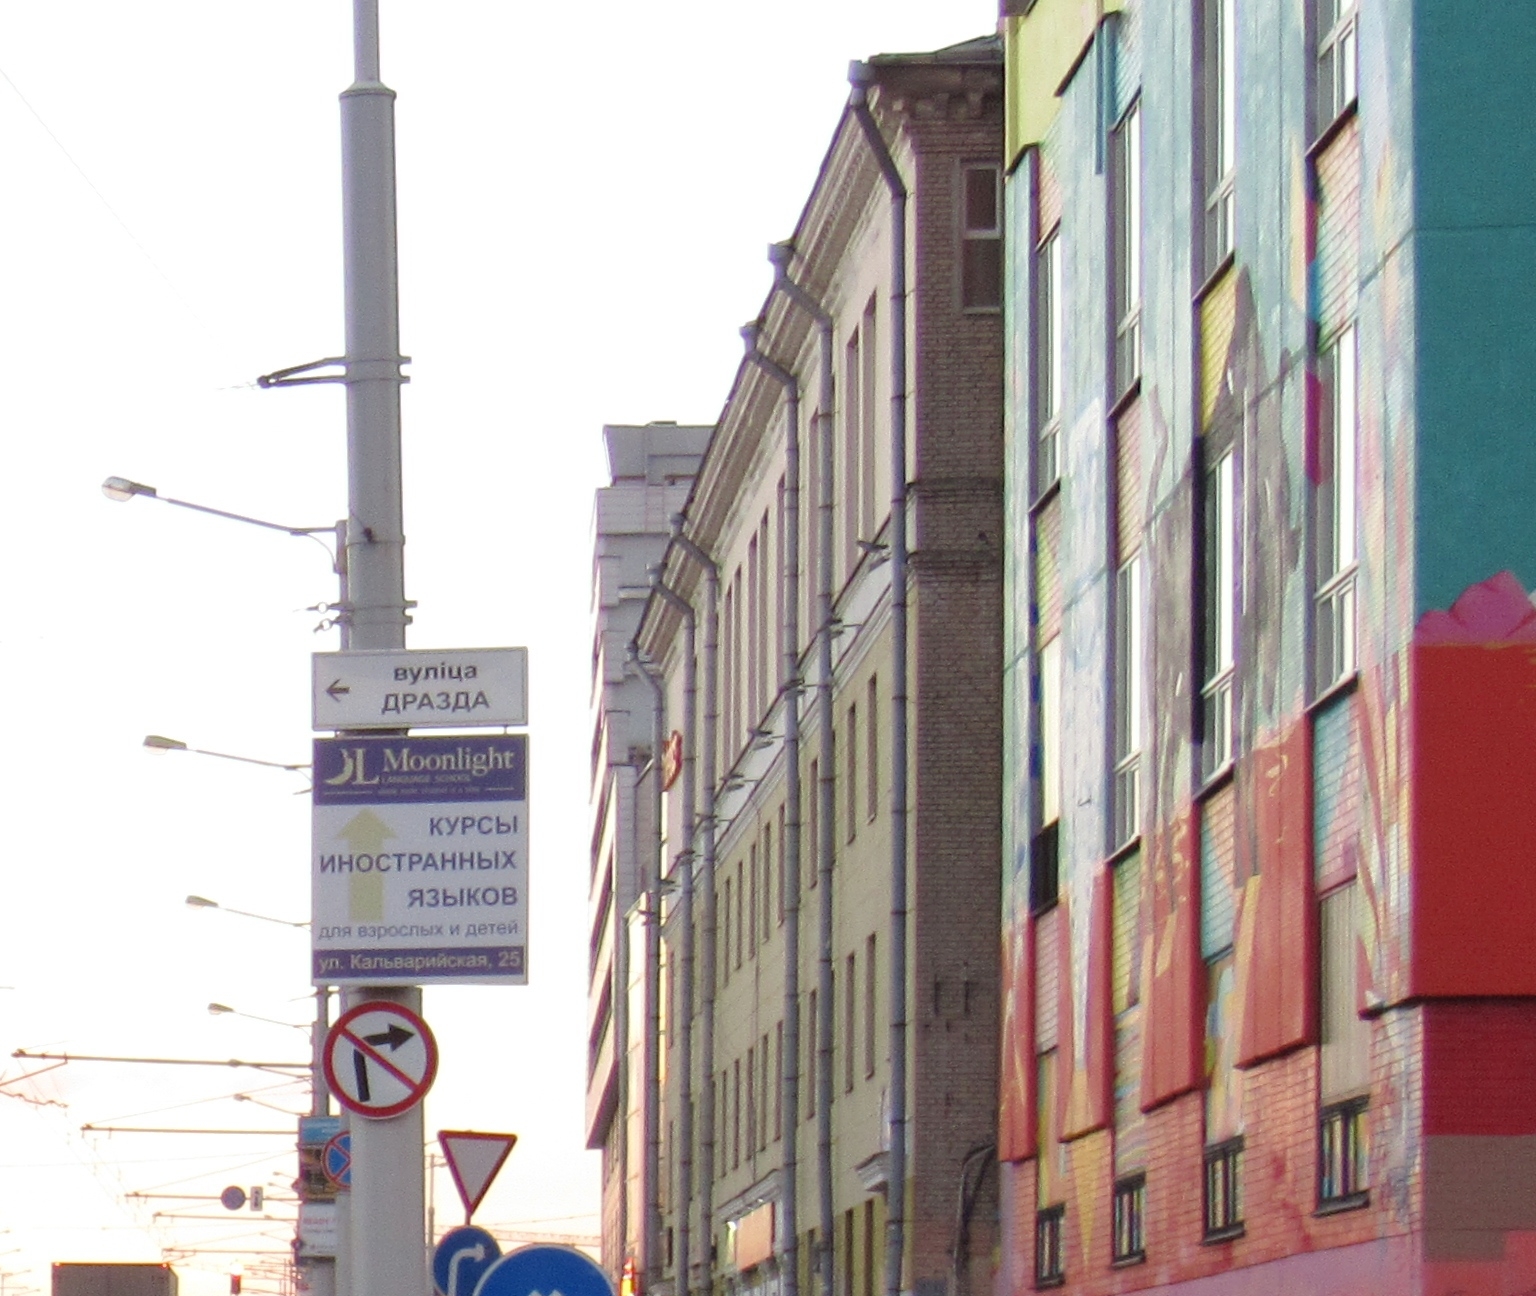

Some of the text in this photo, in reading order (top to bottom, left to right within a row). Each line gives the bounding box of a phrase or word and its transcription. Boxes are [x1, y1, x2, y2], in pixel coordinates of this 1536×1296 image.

[393, 661, 478, 685] вуліца
[381, 690, 490, 715] ДРАЗДА
[383, 747, 514, 777] Moonlight
[429, 816, 518, 836] КУРСЫ
[319, 851, 517, 874] ИНОСТРАННЫХ
[407, 887, 518, 908] ЯЗЫКОВ
[318, 920, 518, 940] для взрослых и детей
[319, 951, 521, 974] ул. Кальварийская, 25
